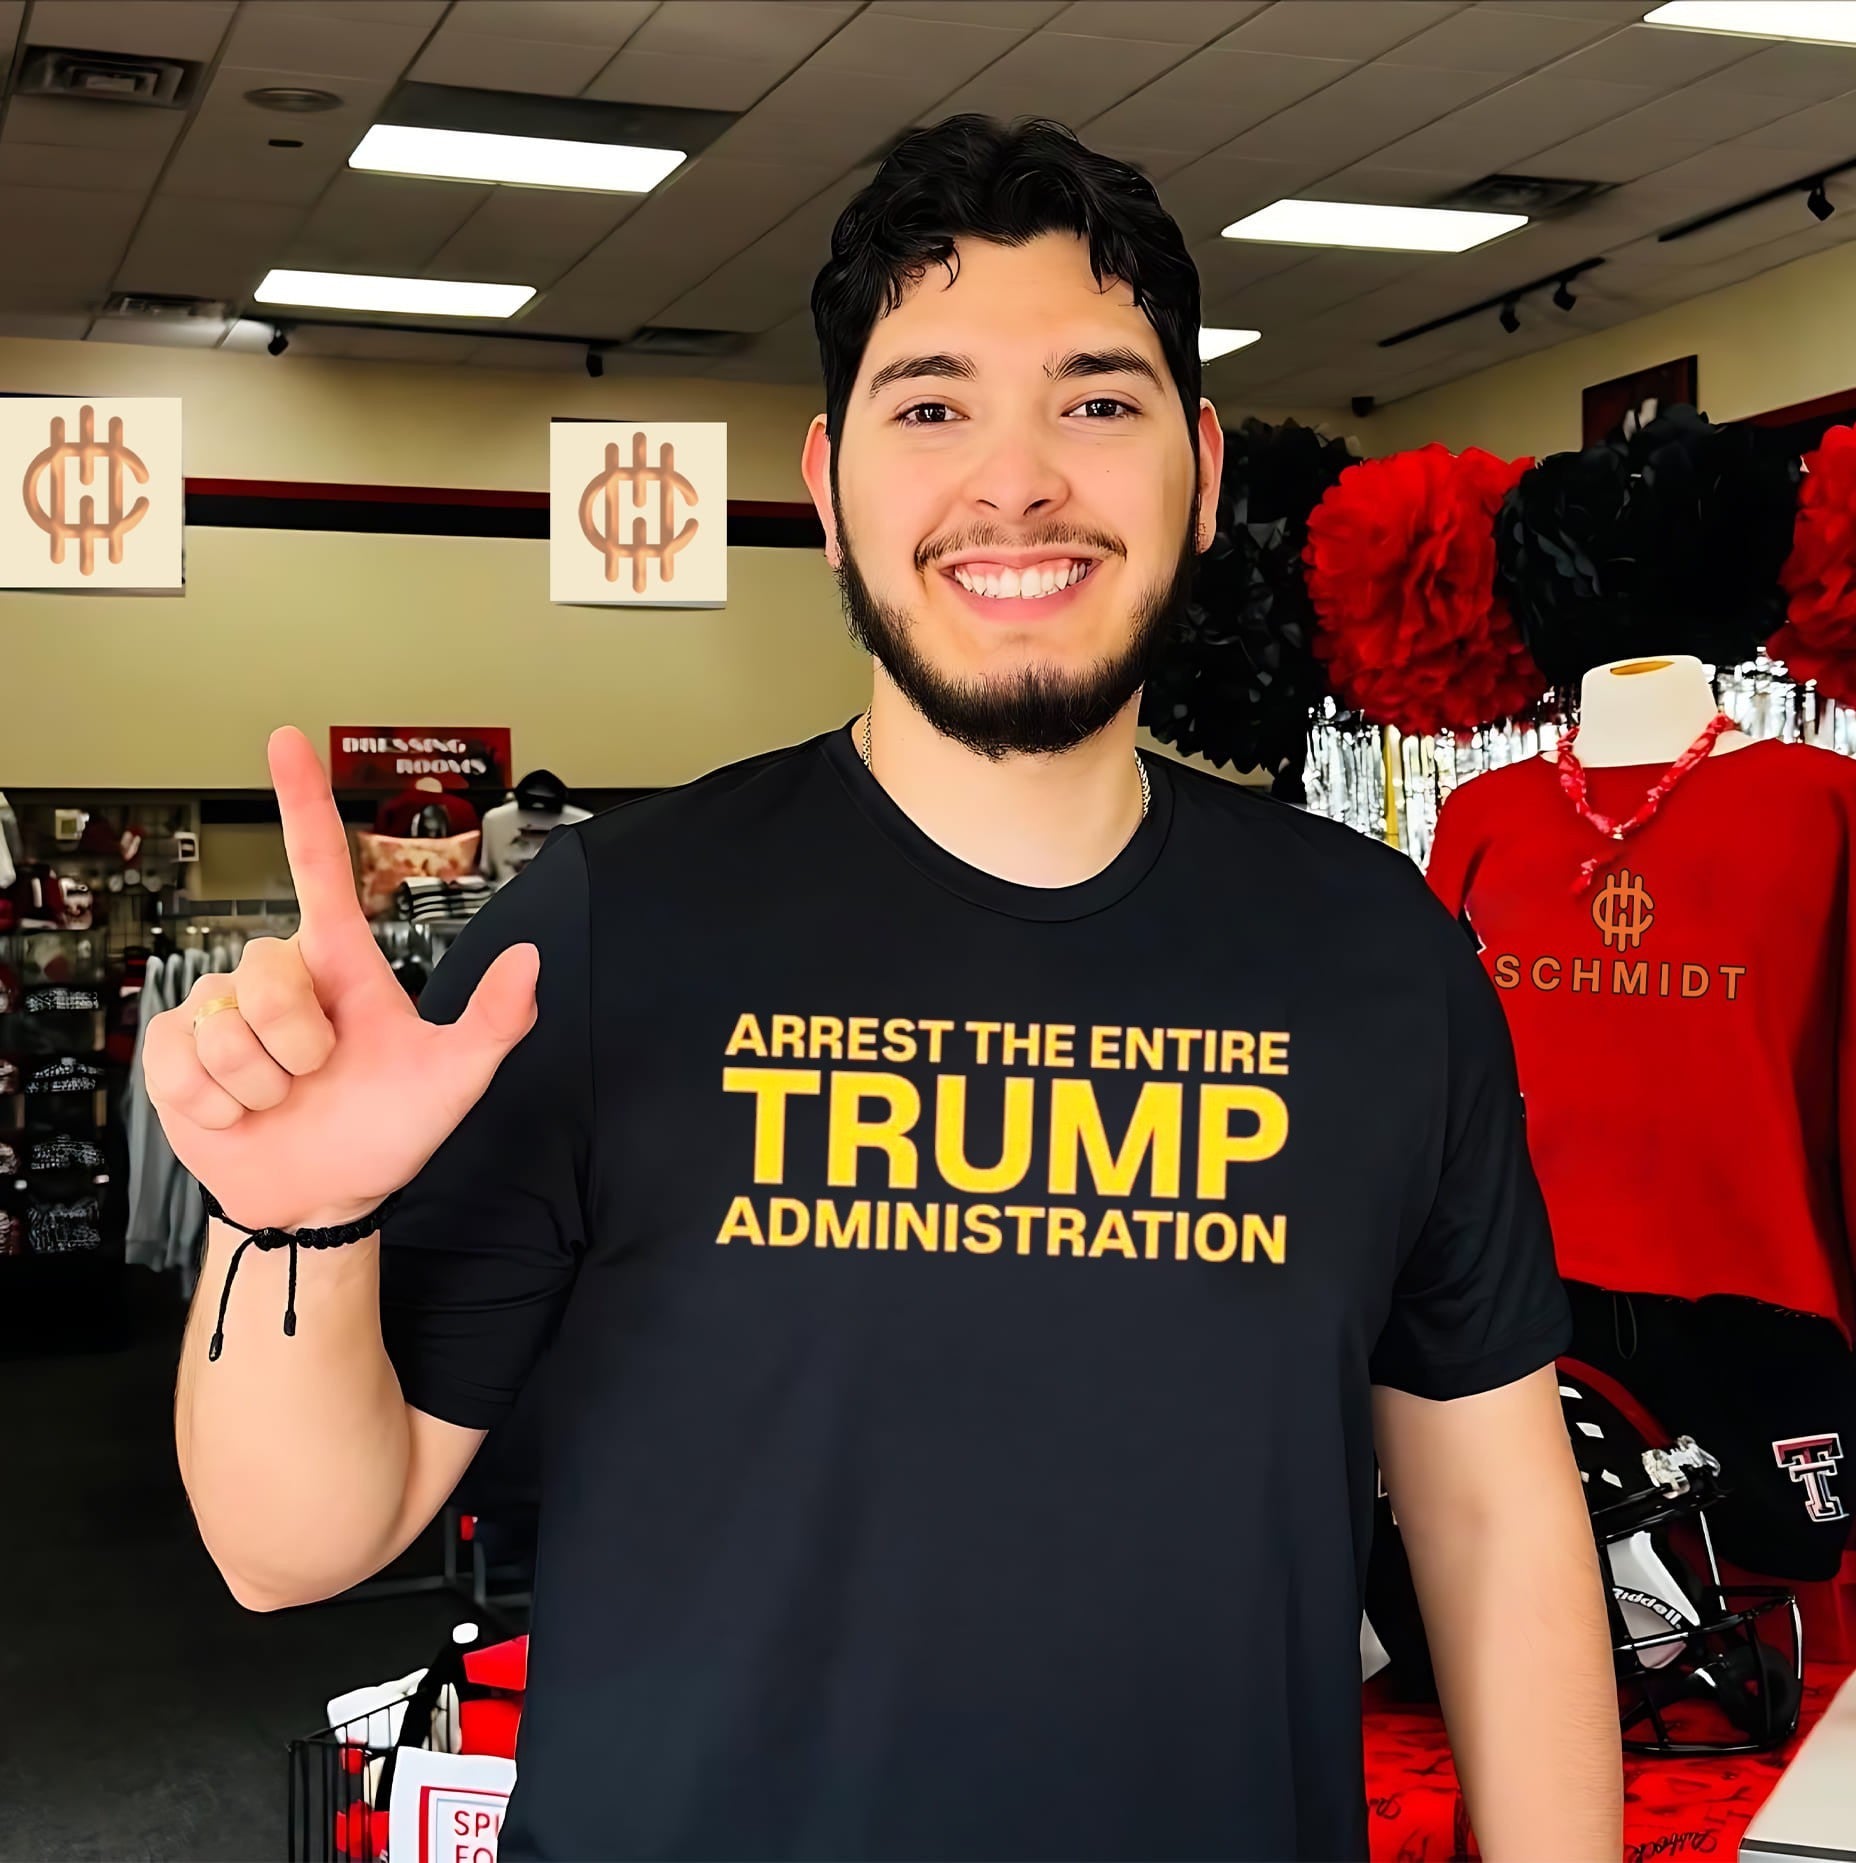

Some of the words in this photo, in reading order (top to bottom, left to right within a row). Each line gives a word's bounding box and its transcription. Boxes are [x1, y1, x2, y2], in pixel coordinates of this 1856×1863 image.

[342, 737, 467, 753] DRESSING
[396, 758, 487, 775] ROOMS
[1494, 953, 1747, 1000] SCHMIDT
[724, 1013, 955, 1064] ARREST
[965, 1020, 1075, 1067] THE
[1090, 1025, 1291, 1075] ENTIRE
[722, 1066, 1290, 1200] TRUMP
[715, 1196, 1287, 1265] ADMINISTRATION
